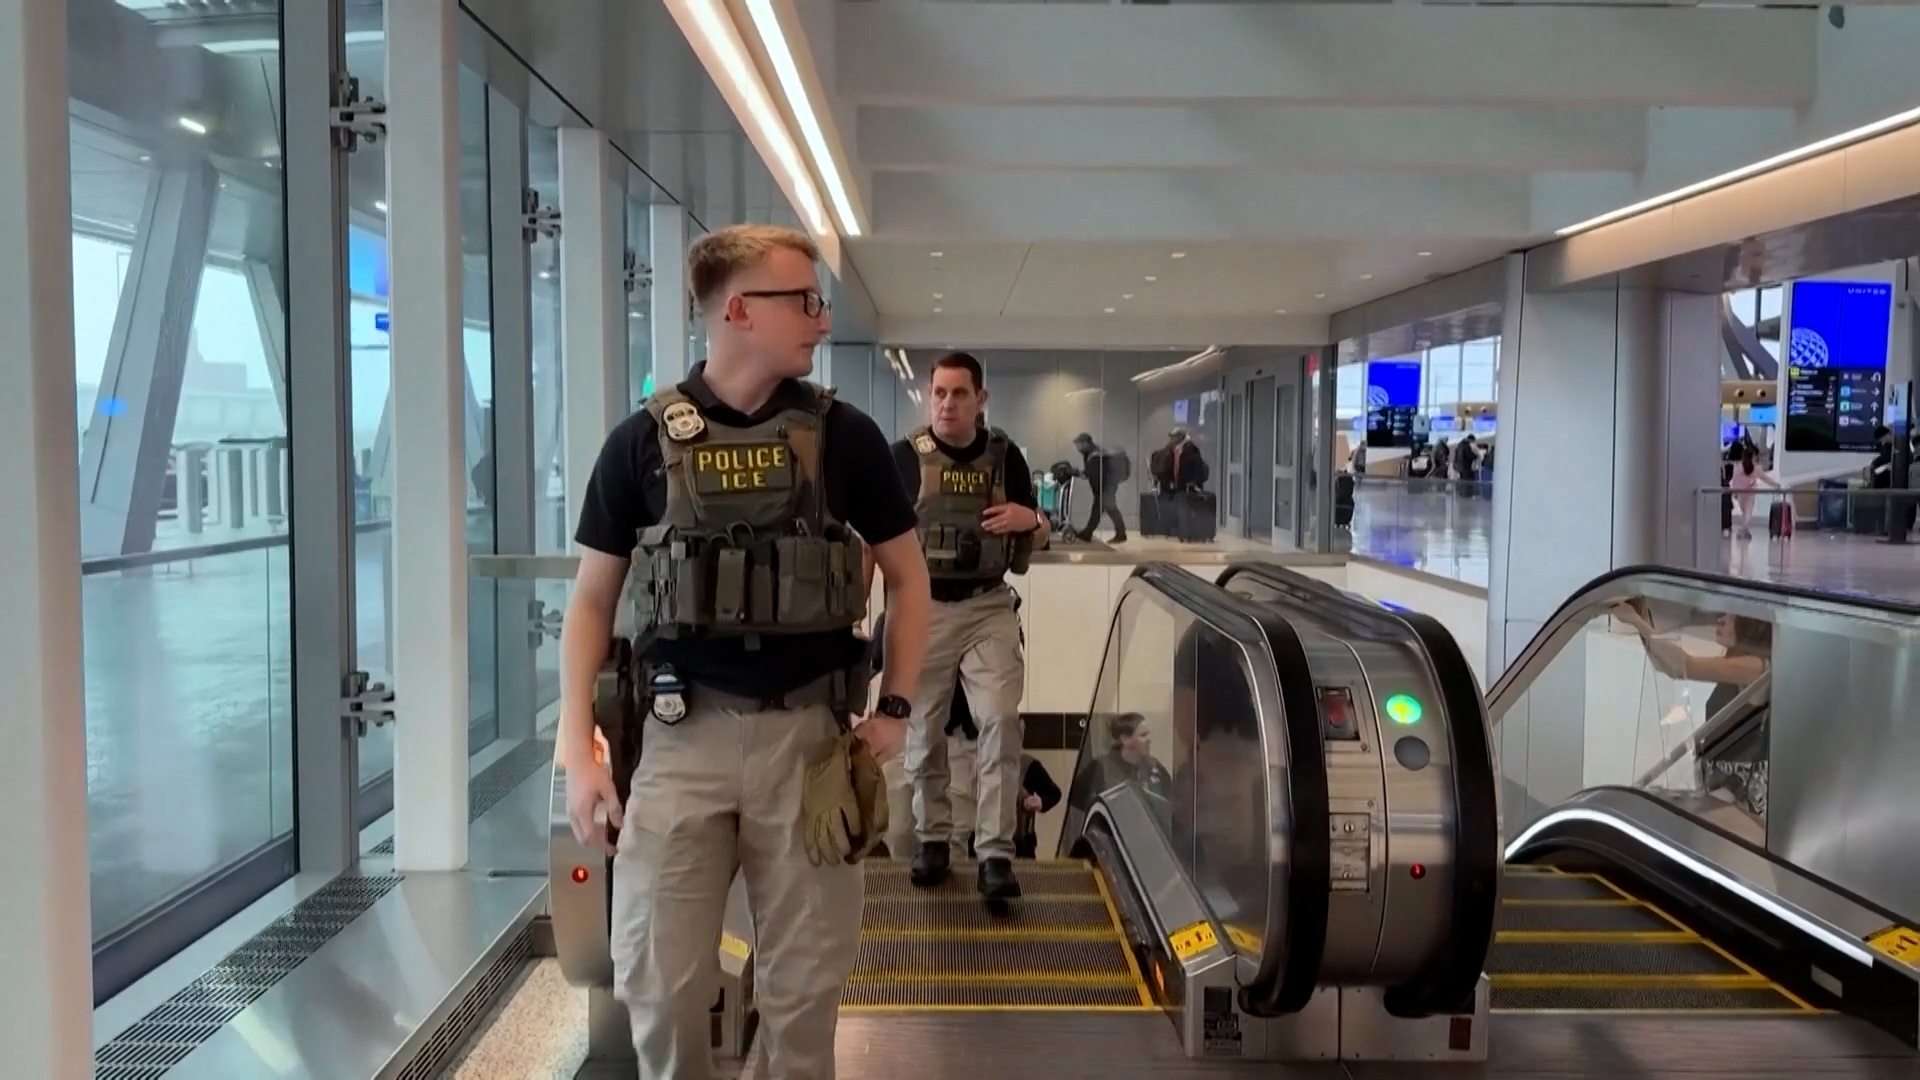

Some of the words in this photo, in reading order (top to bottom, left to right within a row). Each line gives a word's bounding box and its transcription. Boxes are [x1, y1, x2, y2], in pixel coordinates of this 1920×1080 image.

[699, 446, 785, 472] POLICE
[722, 471, 767, 489] ICE
[943, 471, 984, 484] POLICE
[954, 484, 973, 493] ICE
